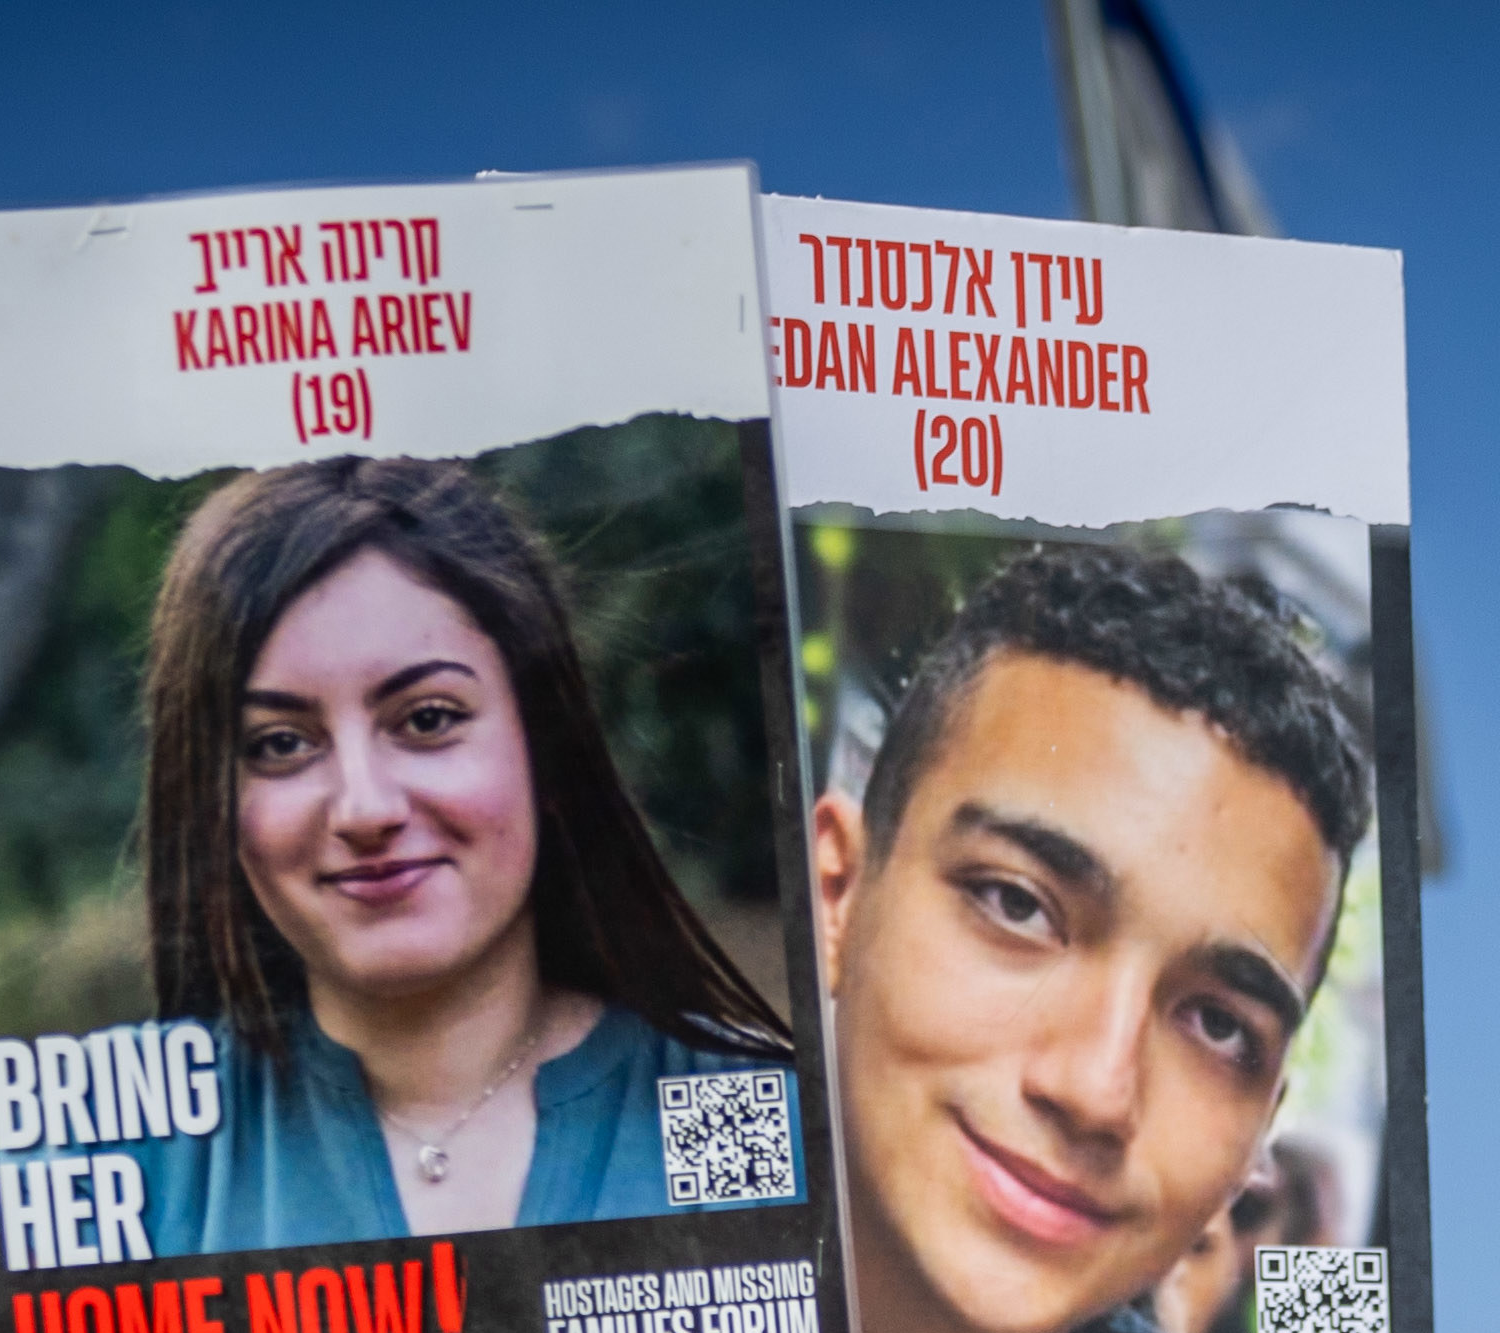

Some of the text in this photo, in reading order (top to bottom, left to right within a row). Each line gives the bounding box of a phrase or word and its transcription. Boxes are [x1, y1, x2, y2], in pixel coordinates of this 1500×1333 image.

[190, 219, 441, 294] קרינה ארייב
[800, 233, 1103, 328] עידן אלכסנדר
[175, 292, 472, 371] KARINA ARIEV
[892, 327, 1150, 414] ALEXANDER
[291, 368, 373, 443] (19)
[914, 409, 1003, 496] (20)
[544, 1260, 815, 1318] HOSTAGES AND MISSING
